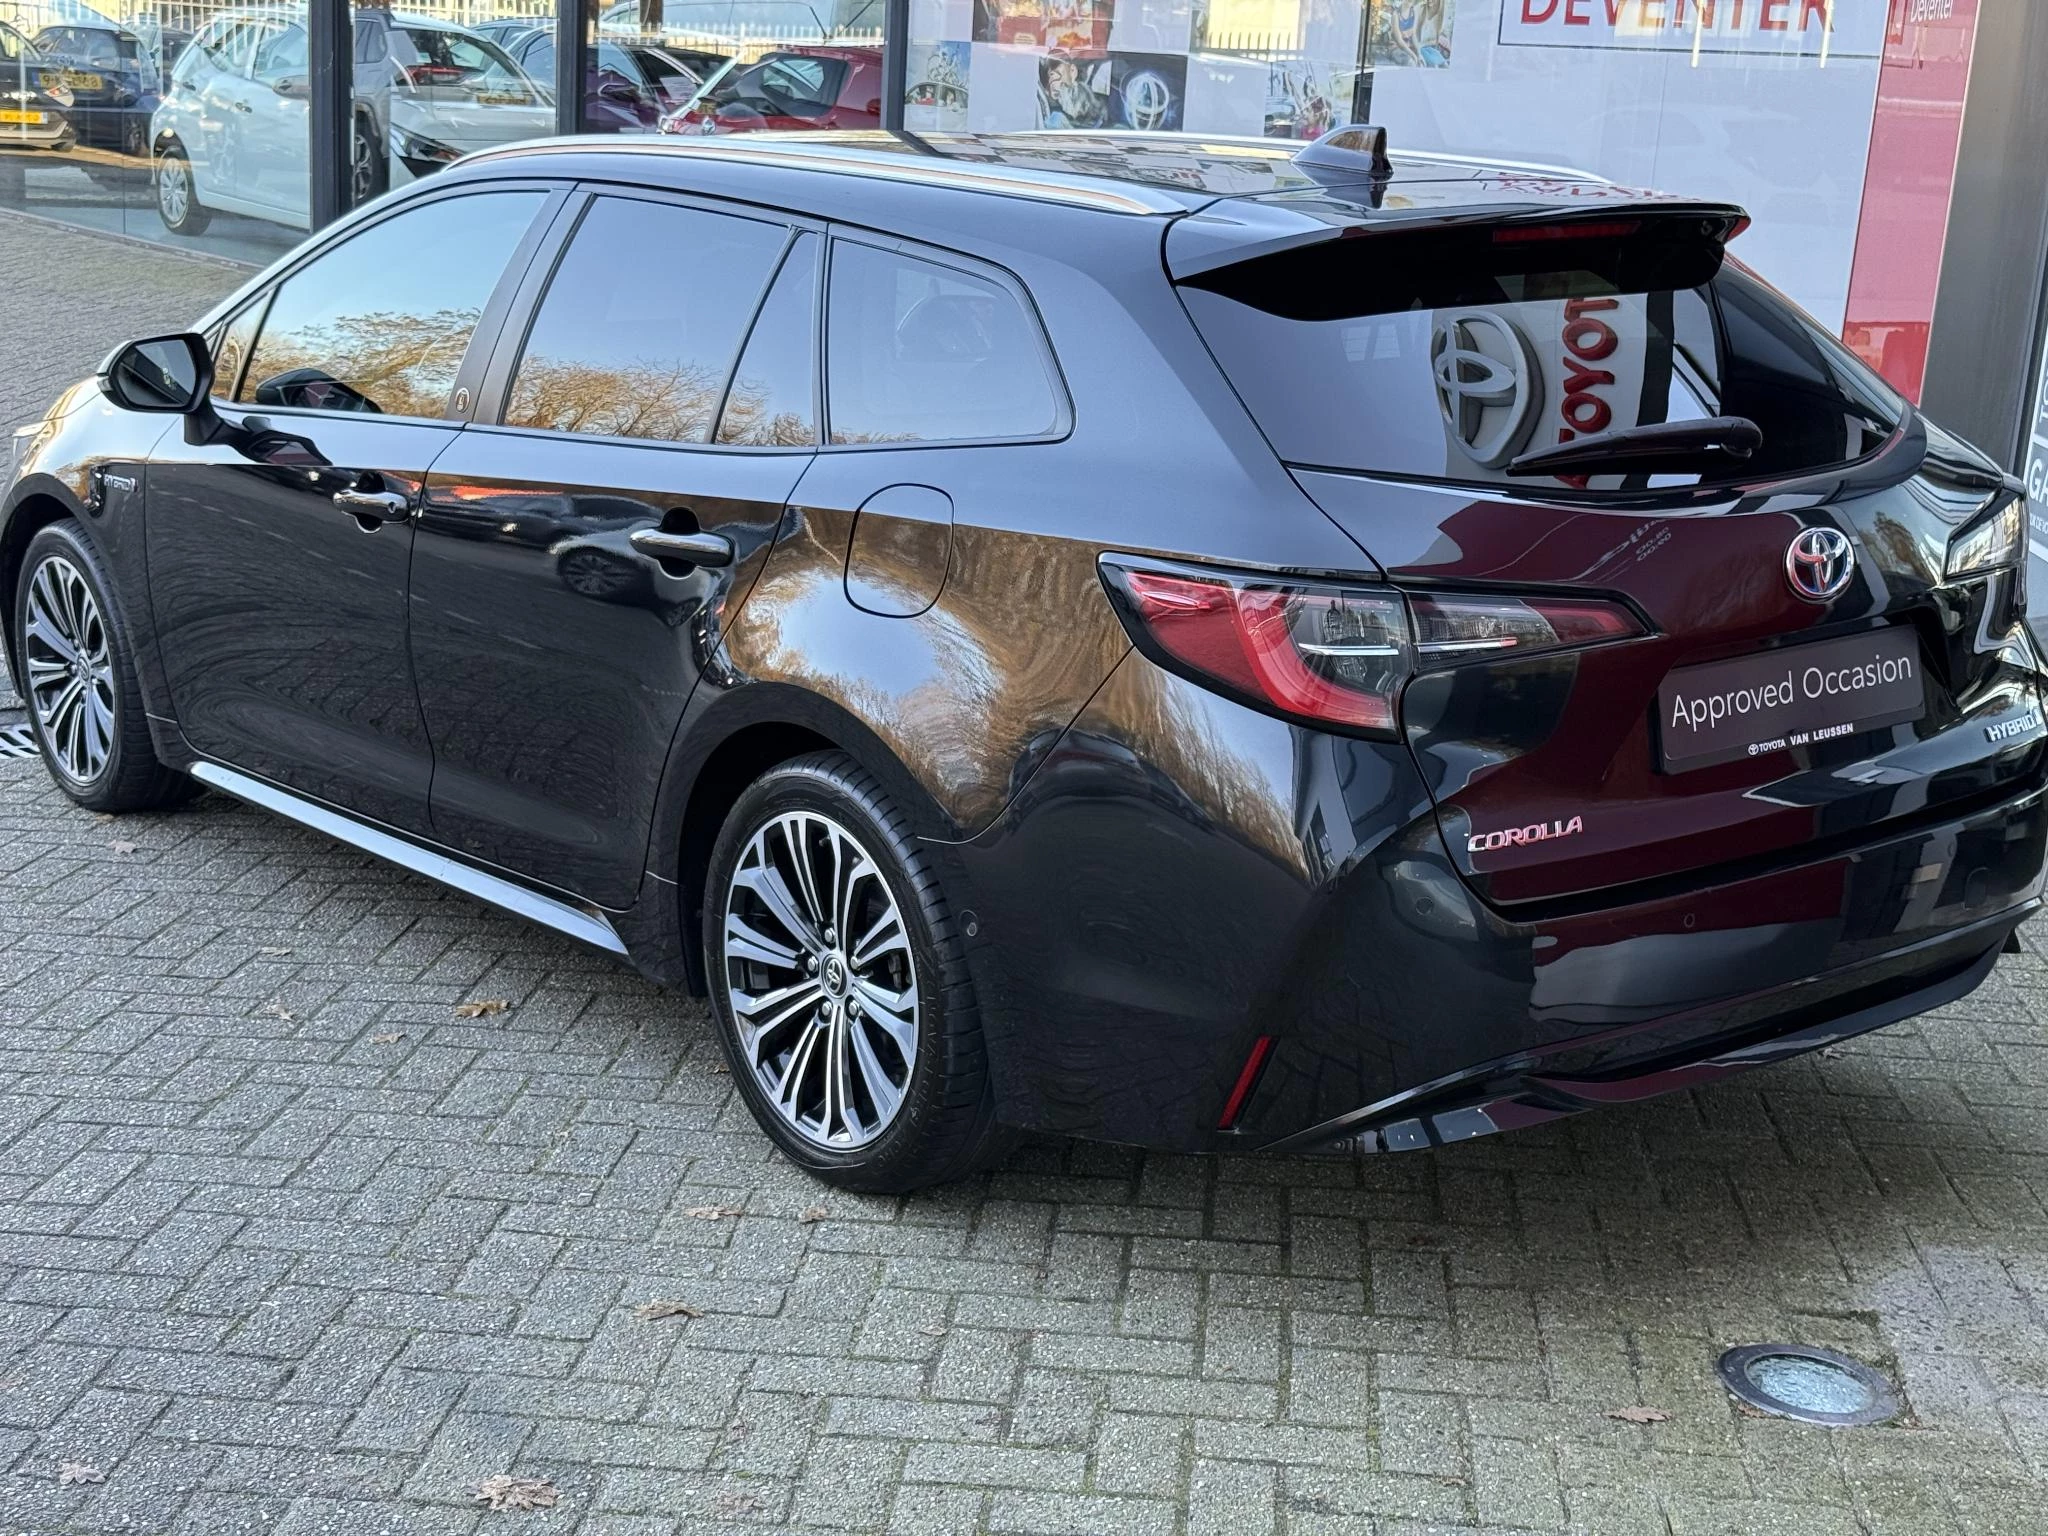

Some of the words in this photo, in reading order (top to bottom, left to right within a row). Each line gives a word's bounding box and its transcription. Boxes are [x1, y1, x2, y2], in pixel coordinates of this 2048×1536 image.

[1672, 671, 1793, 731] Approved
[1803, 655, 1911, 698] Occasion
[1759, 739, 1786, 752] TOYOTA
[1790, 733, 1808, 745] VAN
[1813, 723, 1853, 740] LEUSSEN
[1985, 714, 2037, 742] HYBRID
[1467, 816, 1582, 852] COROLLA
